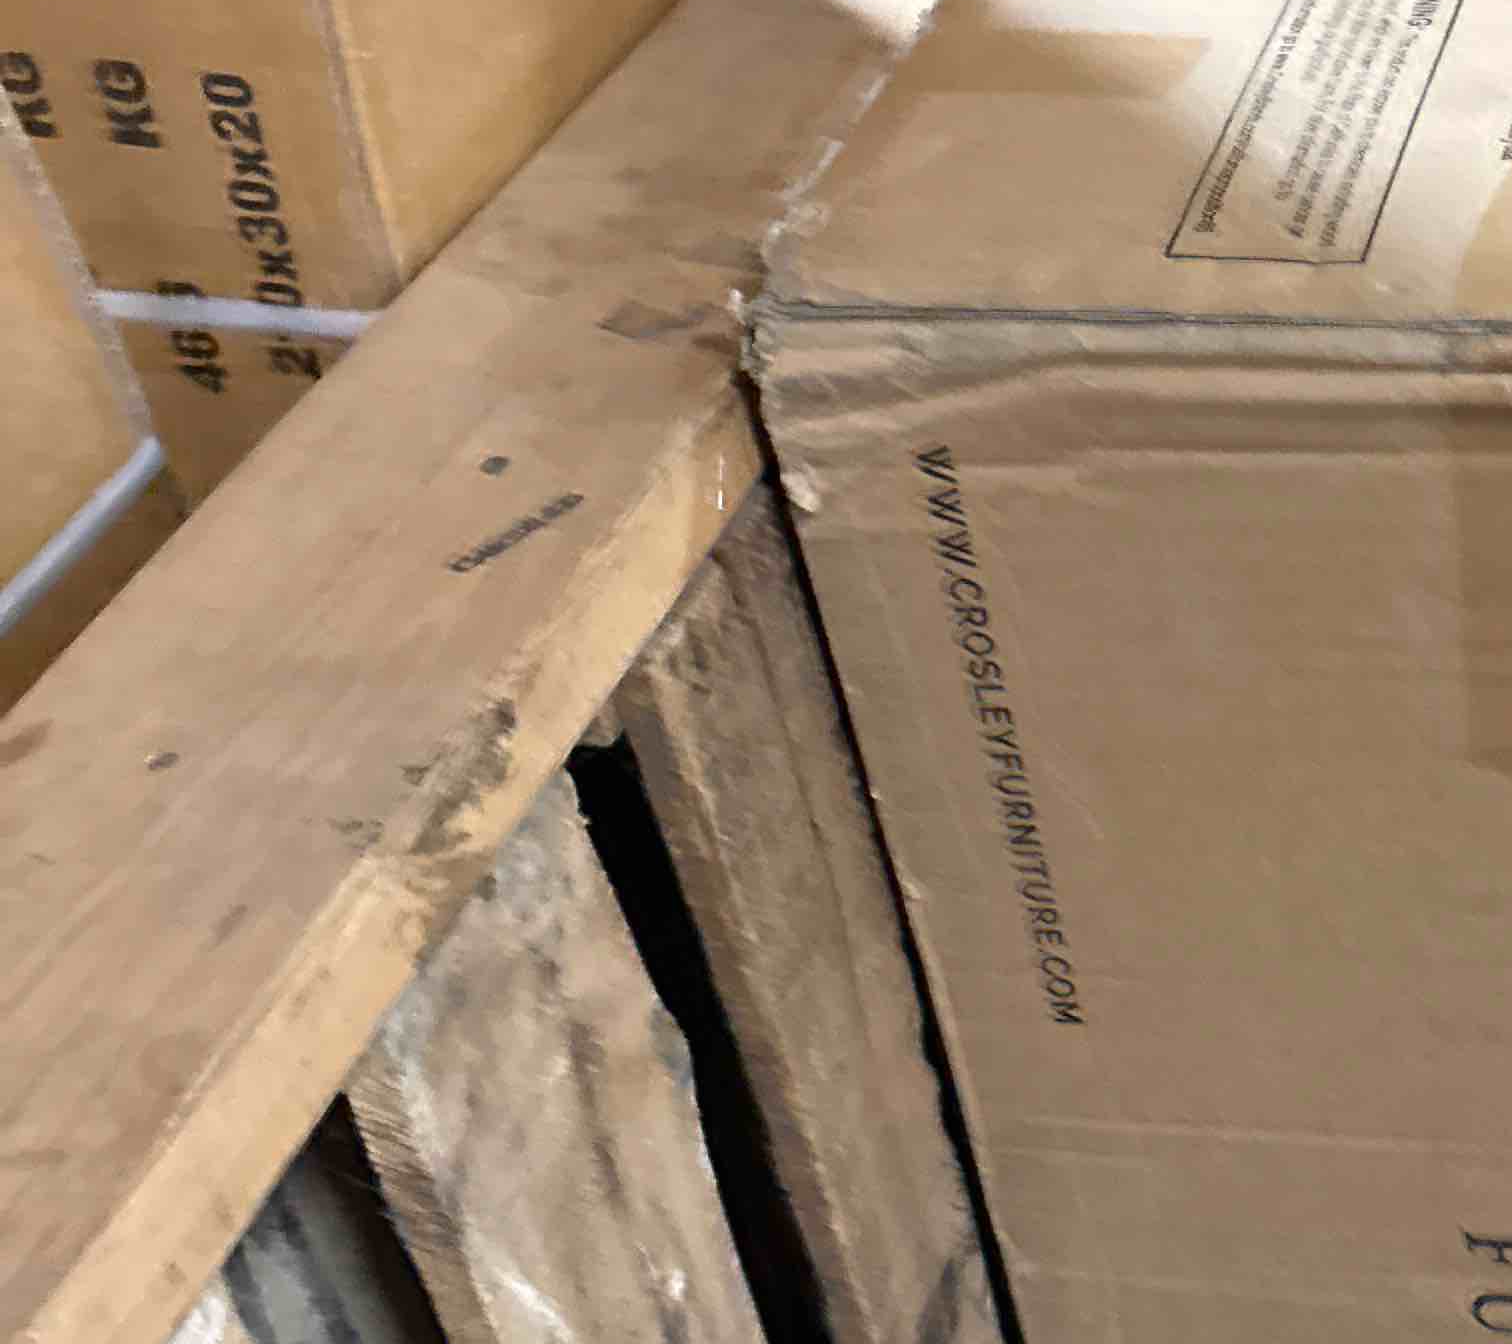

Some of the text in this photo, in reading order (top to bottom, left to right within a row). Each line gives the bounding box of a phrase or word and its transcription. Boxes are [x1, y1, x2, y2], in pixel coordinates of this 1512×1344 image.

[94, 58, 162, 148] KG
[200, 70, 322, 381] 20x30x20
[912, 443, 1087, 1027] WWW.CROSLEYFURNITURE.COM
